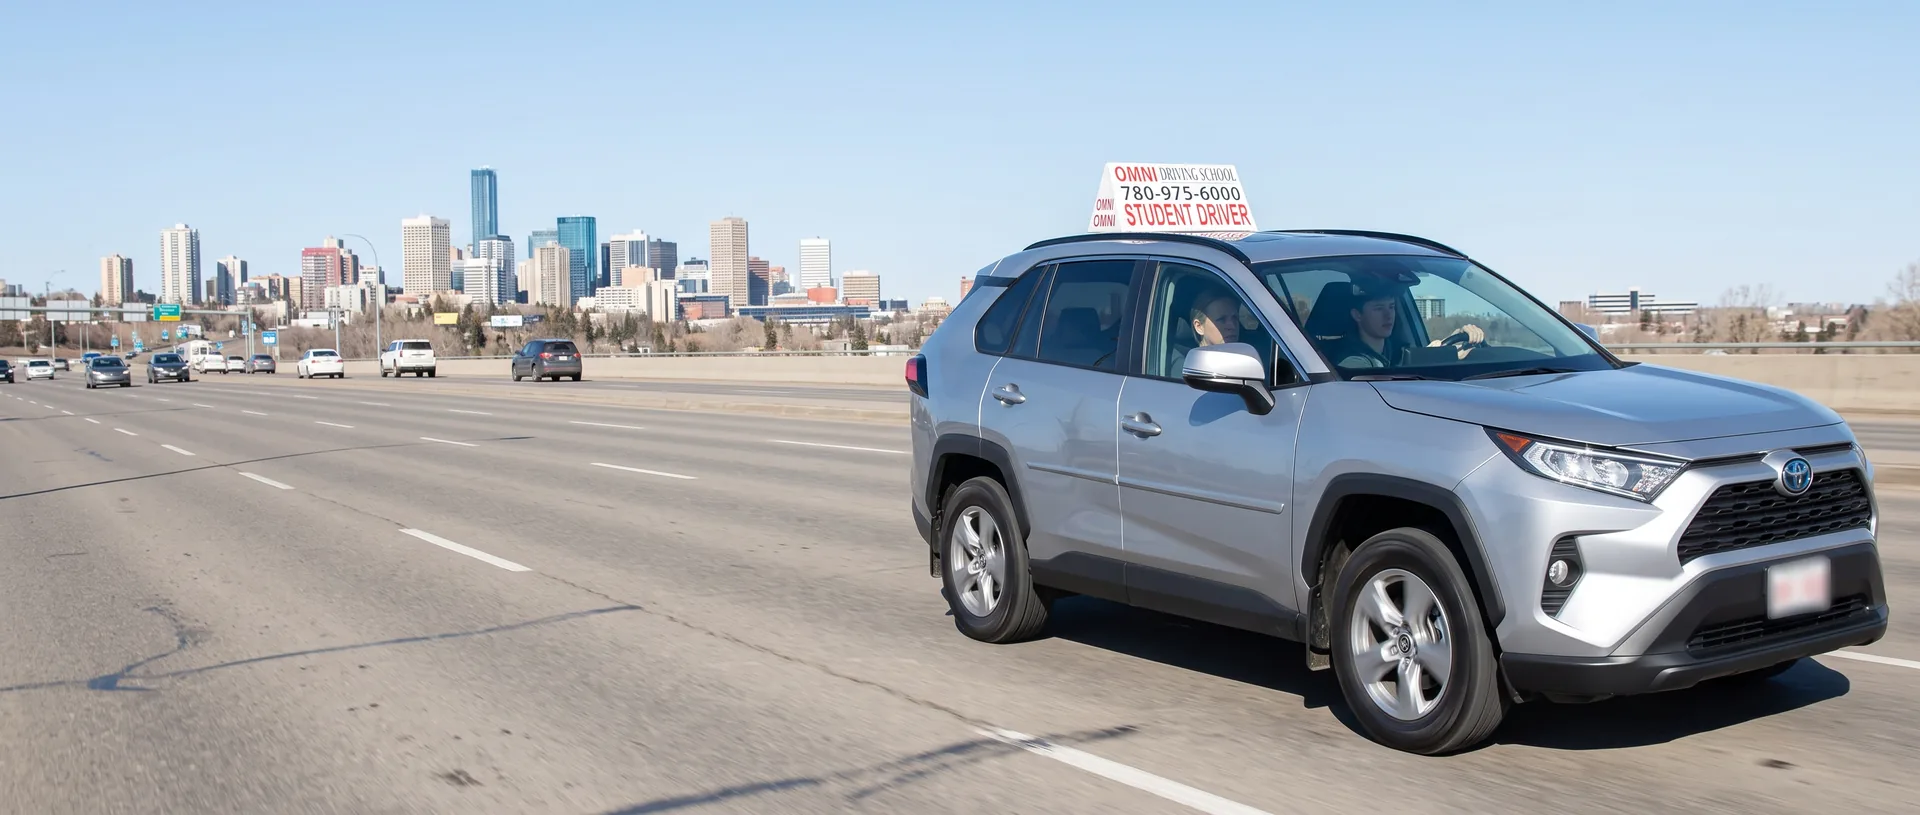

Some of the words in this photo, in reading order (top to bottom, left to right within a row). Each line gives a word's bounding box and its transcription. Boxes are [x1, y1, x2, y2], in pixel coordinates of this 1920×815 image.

[1115, 166, 1158, 182] OMNI
[1159, 167, 1199, 181] DRIVING
[1199, 168, 1237, 181] SCHOOL
[1120, 186, 1241, 201] 780-975-6000
[1096, 199, 1114, 211] OMNI
[1093, 214, 1116, 227] OMNI
[1124, 203, 1193, 226] STUDENT
[1196, 204, 1252, 226] DRIVER
